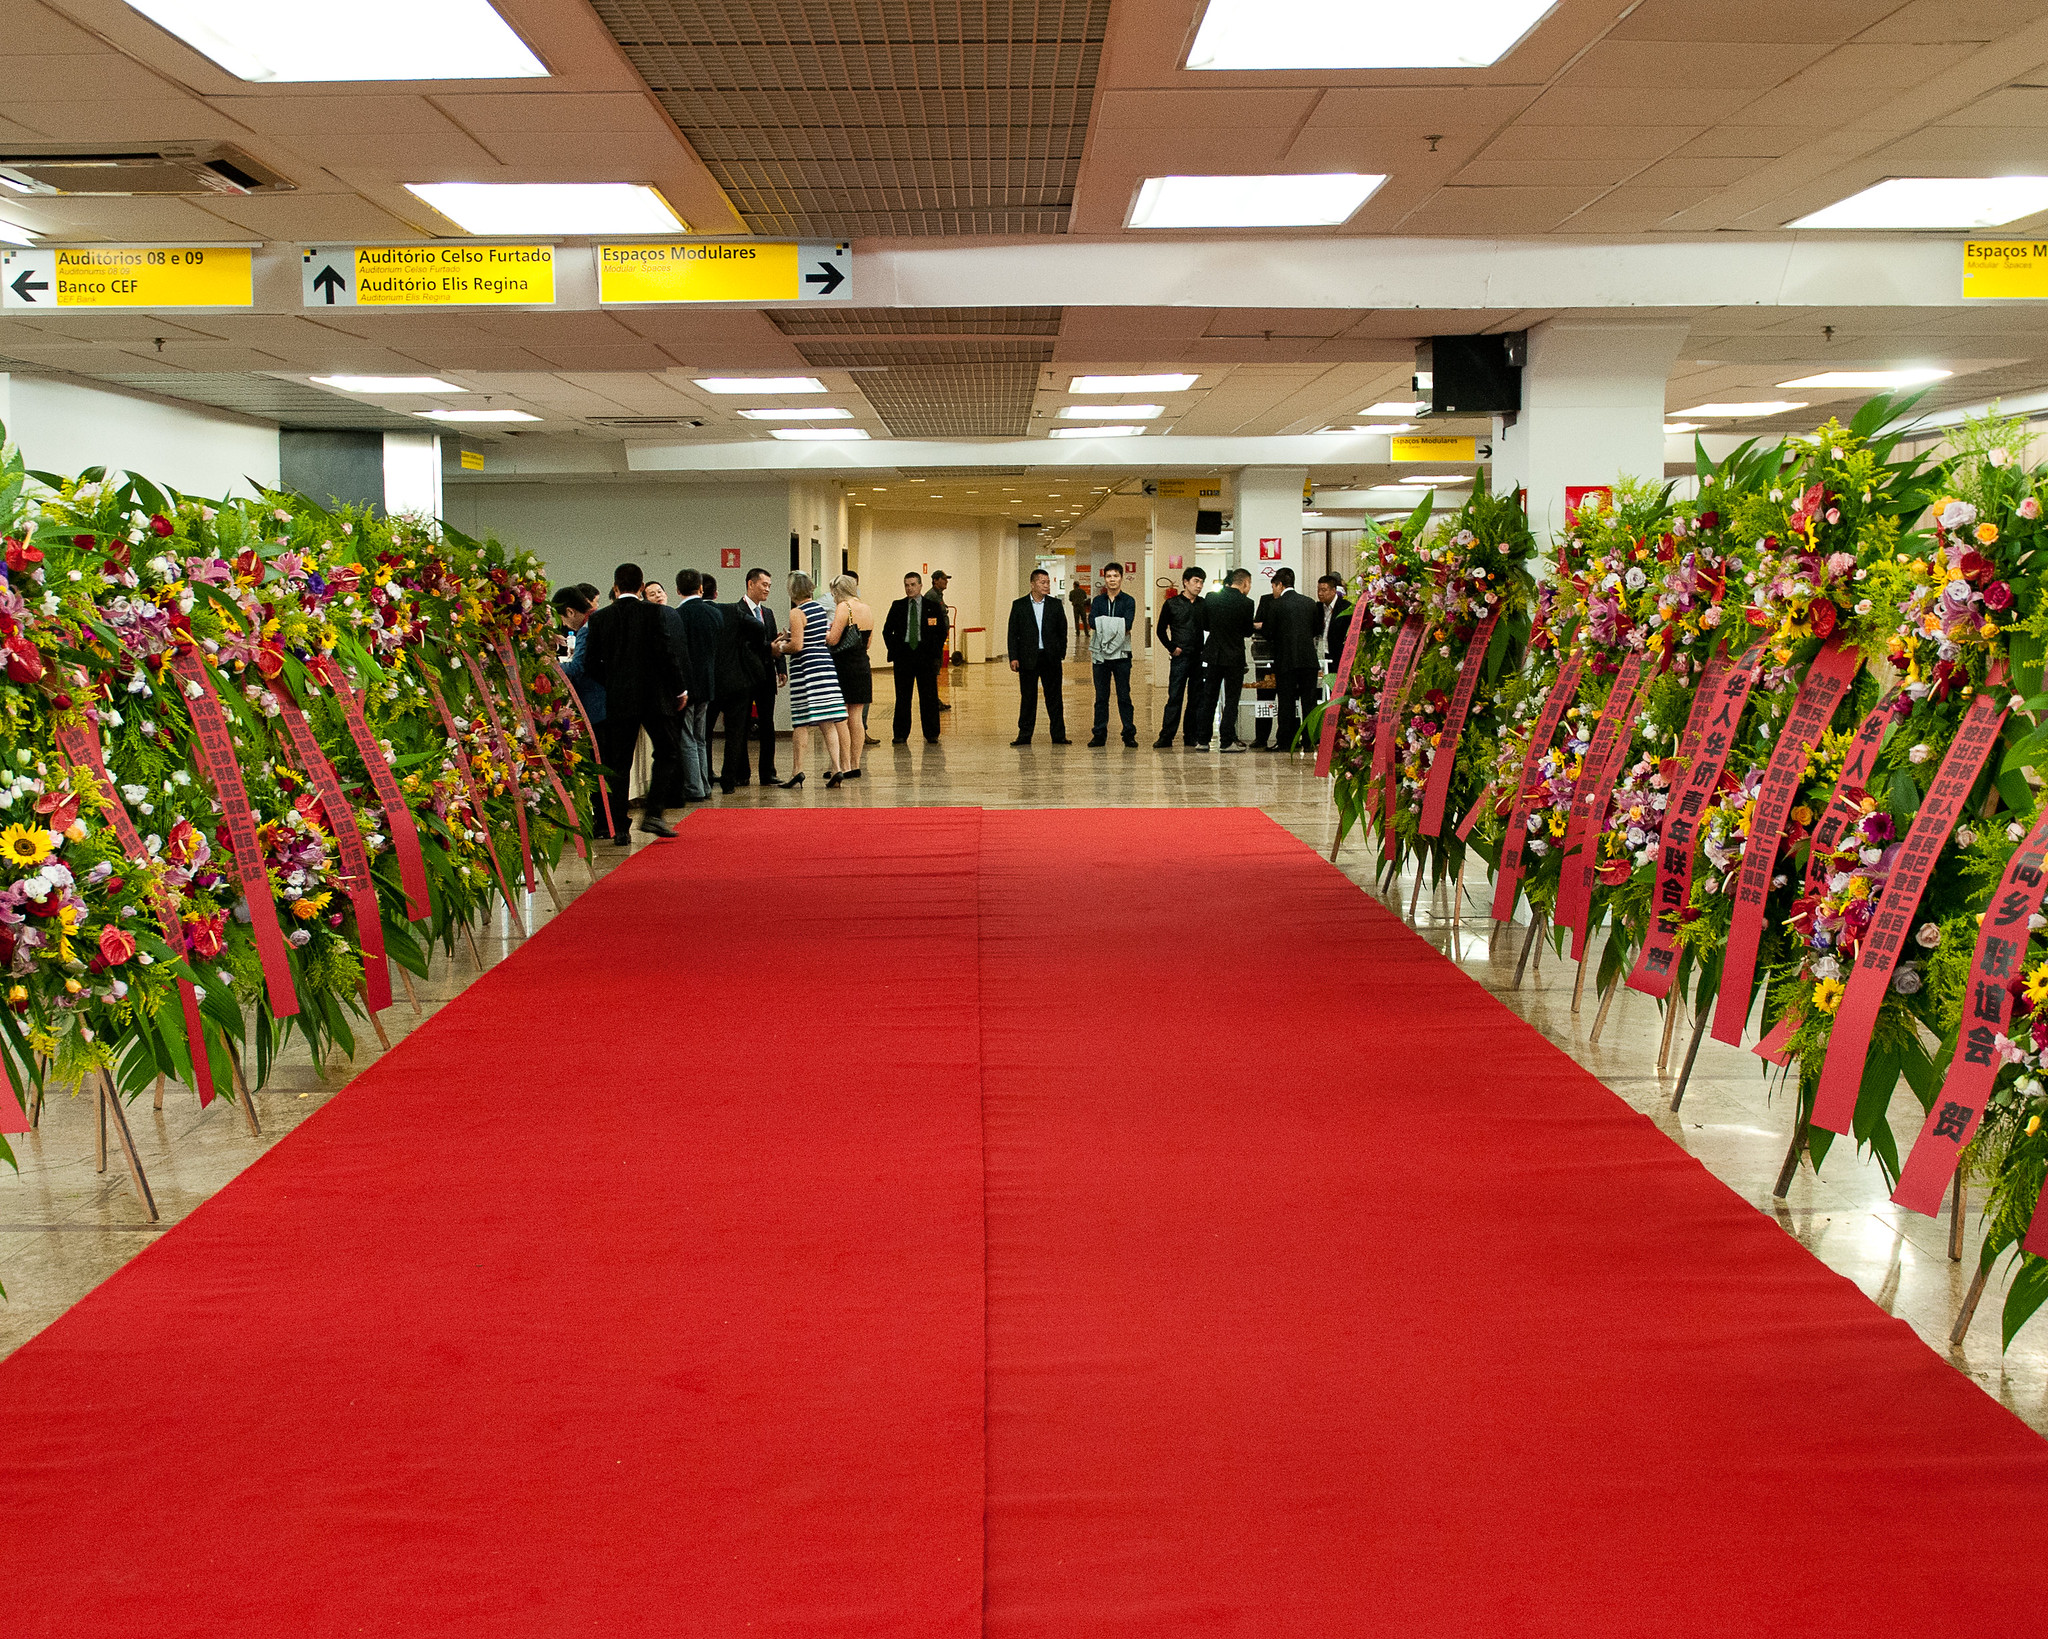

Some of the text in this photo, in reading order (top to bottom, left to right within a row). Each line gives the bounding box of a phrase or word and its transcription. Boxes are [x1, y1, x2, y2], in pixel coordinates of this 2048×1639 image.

[58, 251, 204, 265] Auditórios 08 e 09
[359, 248, 551, 263] Auditório Celso Furtado
[603, 245, 756, 264] Espaços Modulares
[1967, 244, 2027, 260] Espaços
[359, 265, 461, 274] Auditorium Celso Furtado
[603, 264, 671, 273] Modular Spaces
[58, 280, 138, 293] Banco CEF
[360, 277, 528, 294] Auditório Elis Regina
[57, 295, 97, 303] CEF Bank
[360, 293, 451, 303] Auditorium Elis Regina
[1644, 947, 1674, 976] 贺
[1932, 1100, 1974, 1145] 贺
